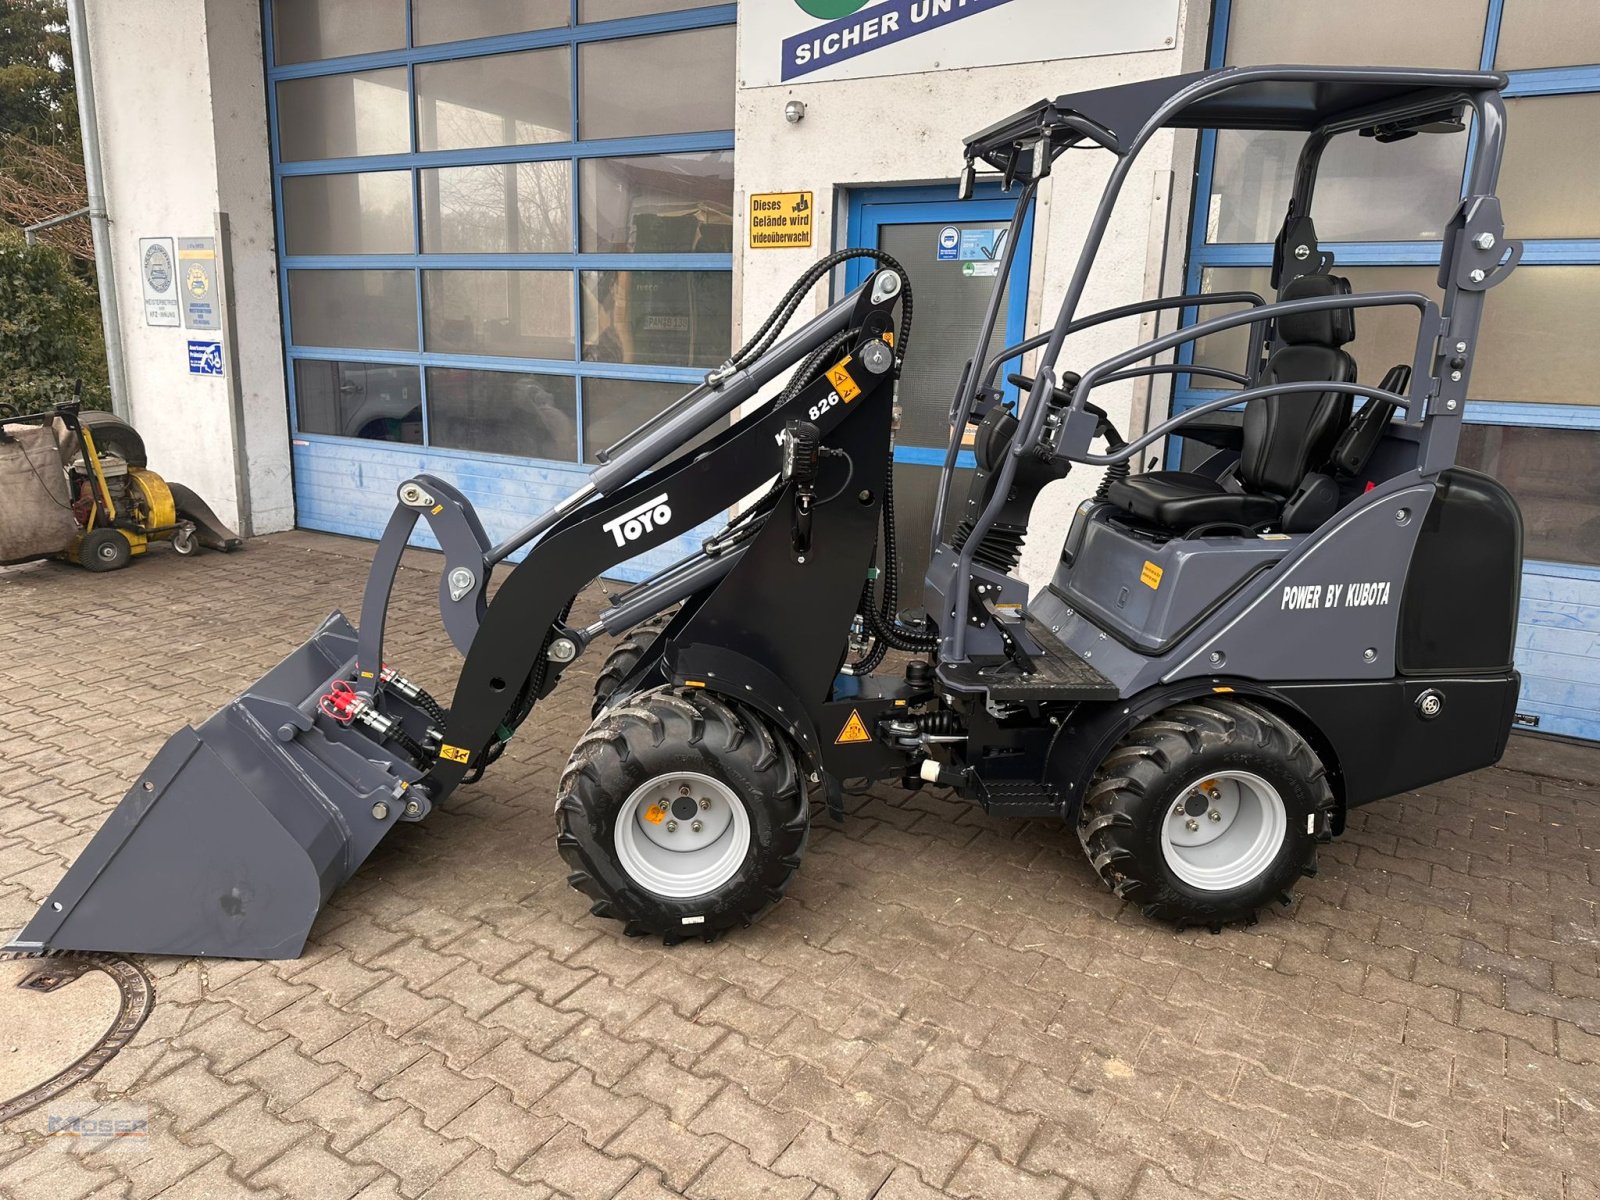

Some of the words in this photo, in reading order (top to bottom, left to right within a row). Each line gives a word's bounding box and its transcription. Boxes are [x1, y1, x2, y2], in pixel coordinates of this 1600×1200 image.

[794, 11, 900, 65] SICHER
[910, 0, 978, 23] UN
[753, 199, 782, 211] Dieses
[753, 215, 787, 227] Gelände
[789, 214, 809, 226] wird
[752, 231, 809, 243] videoüberwacht
[808, 391, 840, 421] 826
[1281, 585, 1322, 610] POWER
[1324, 584, 1344, 608] BY
[1344, 581, 1391, 607] KUBOTA
